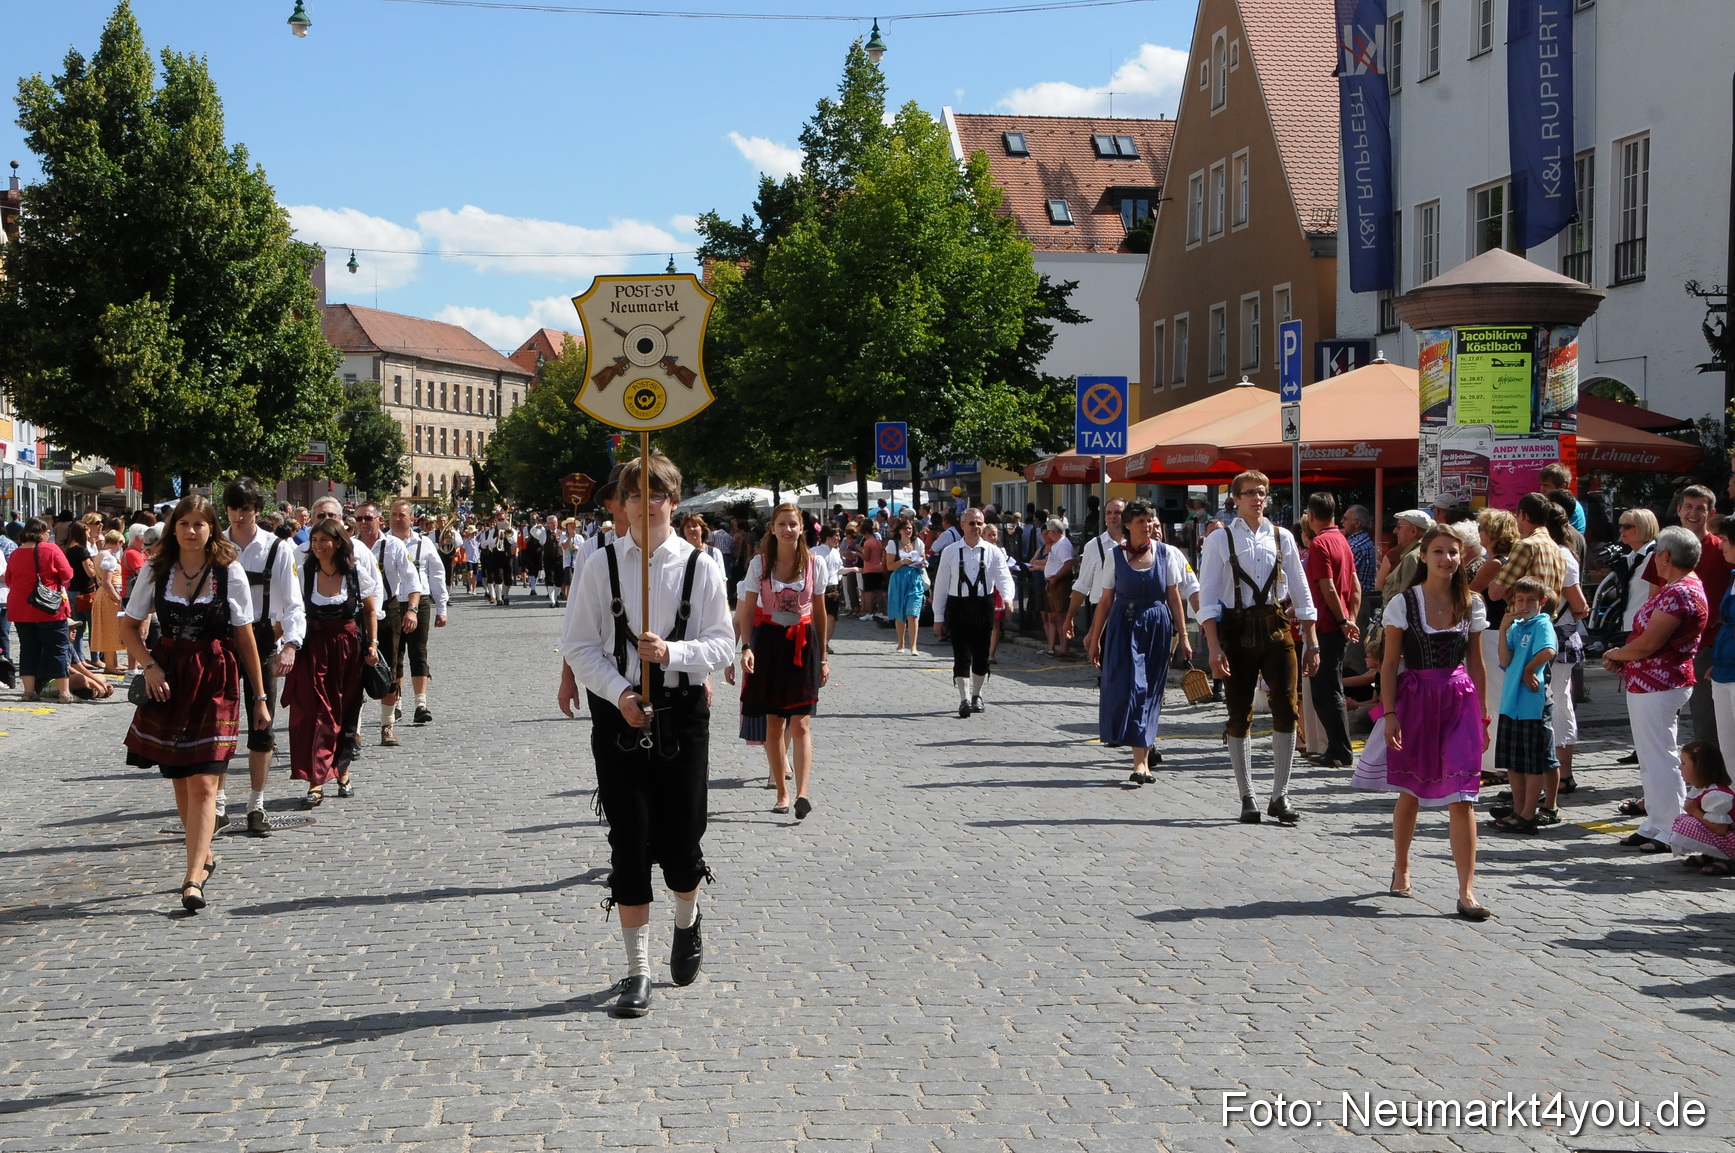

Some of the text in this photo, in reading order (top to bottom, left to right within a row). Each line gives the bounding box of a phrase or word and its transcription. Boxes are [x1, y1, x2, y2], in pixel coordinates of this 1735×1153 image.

[1538, 4, 1562, 199] K&L RUPPERT
[610, 299, 680, 314] Neumarkt
[1460, 330, 1528, 341] Jacobikirwa
[1283, 330, 1297, 376] P
[1466, 341, 1522, 352] Köstlbach
[1080, 431, 1122, 448] TAXI
[1493, 445, 1519, 454] ANDY
[1591, 447, 1661, 464] Lehmeier
[879, 454, 904, 465] TAXI
